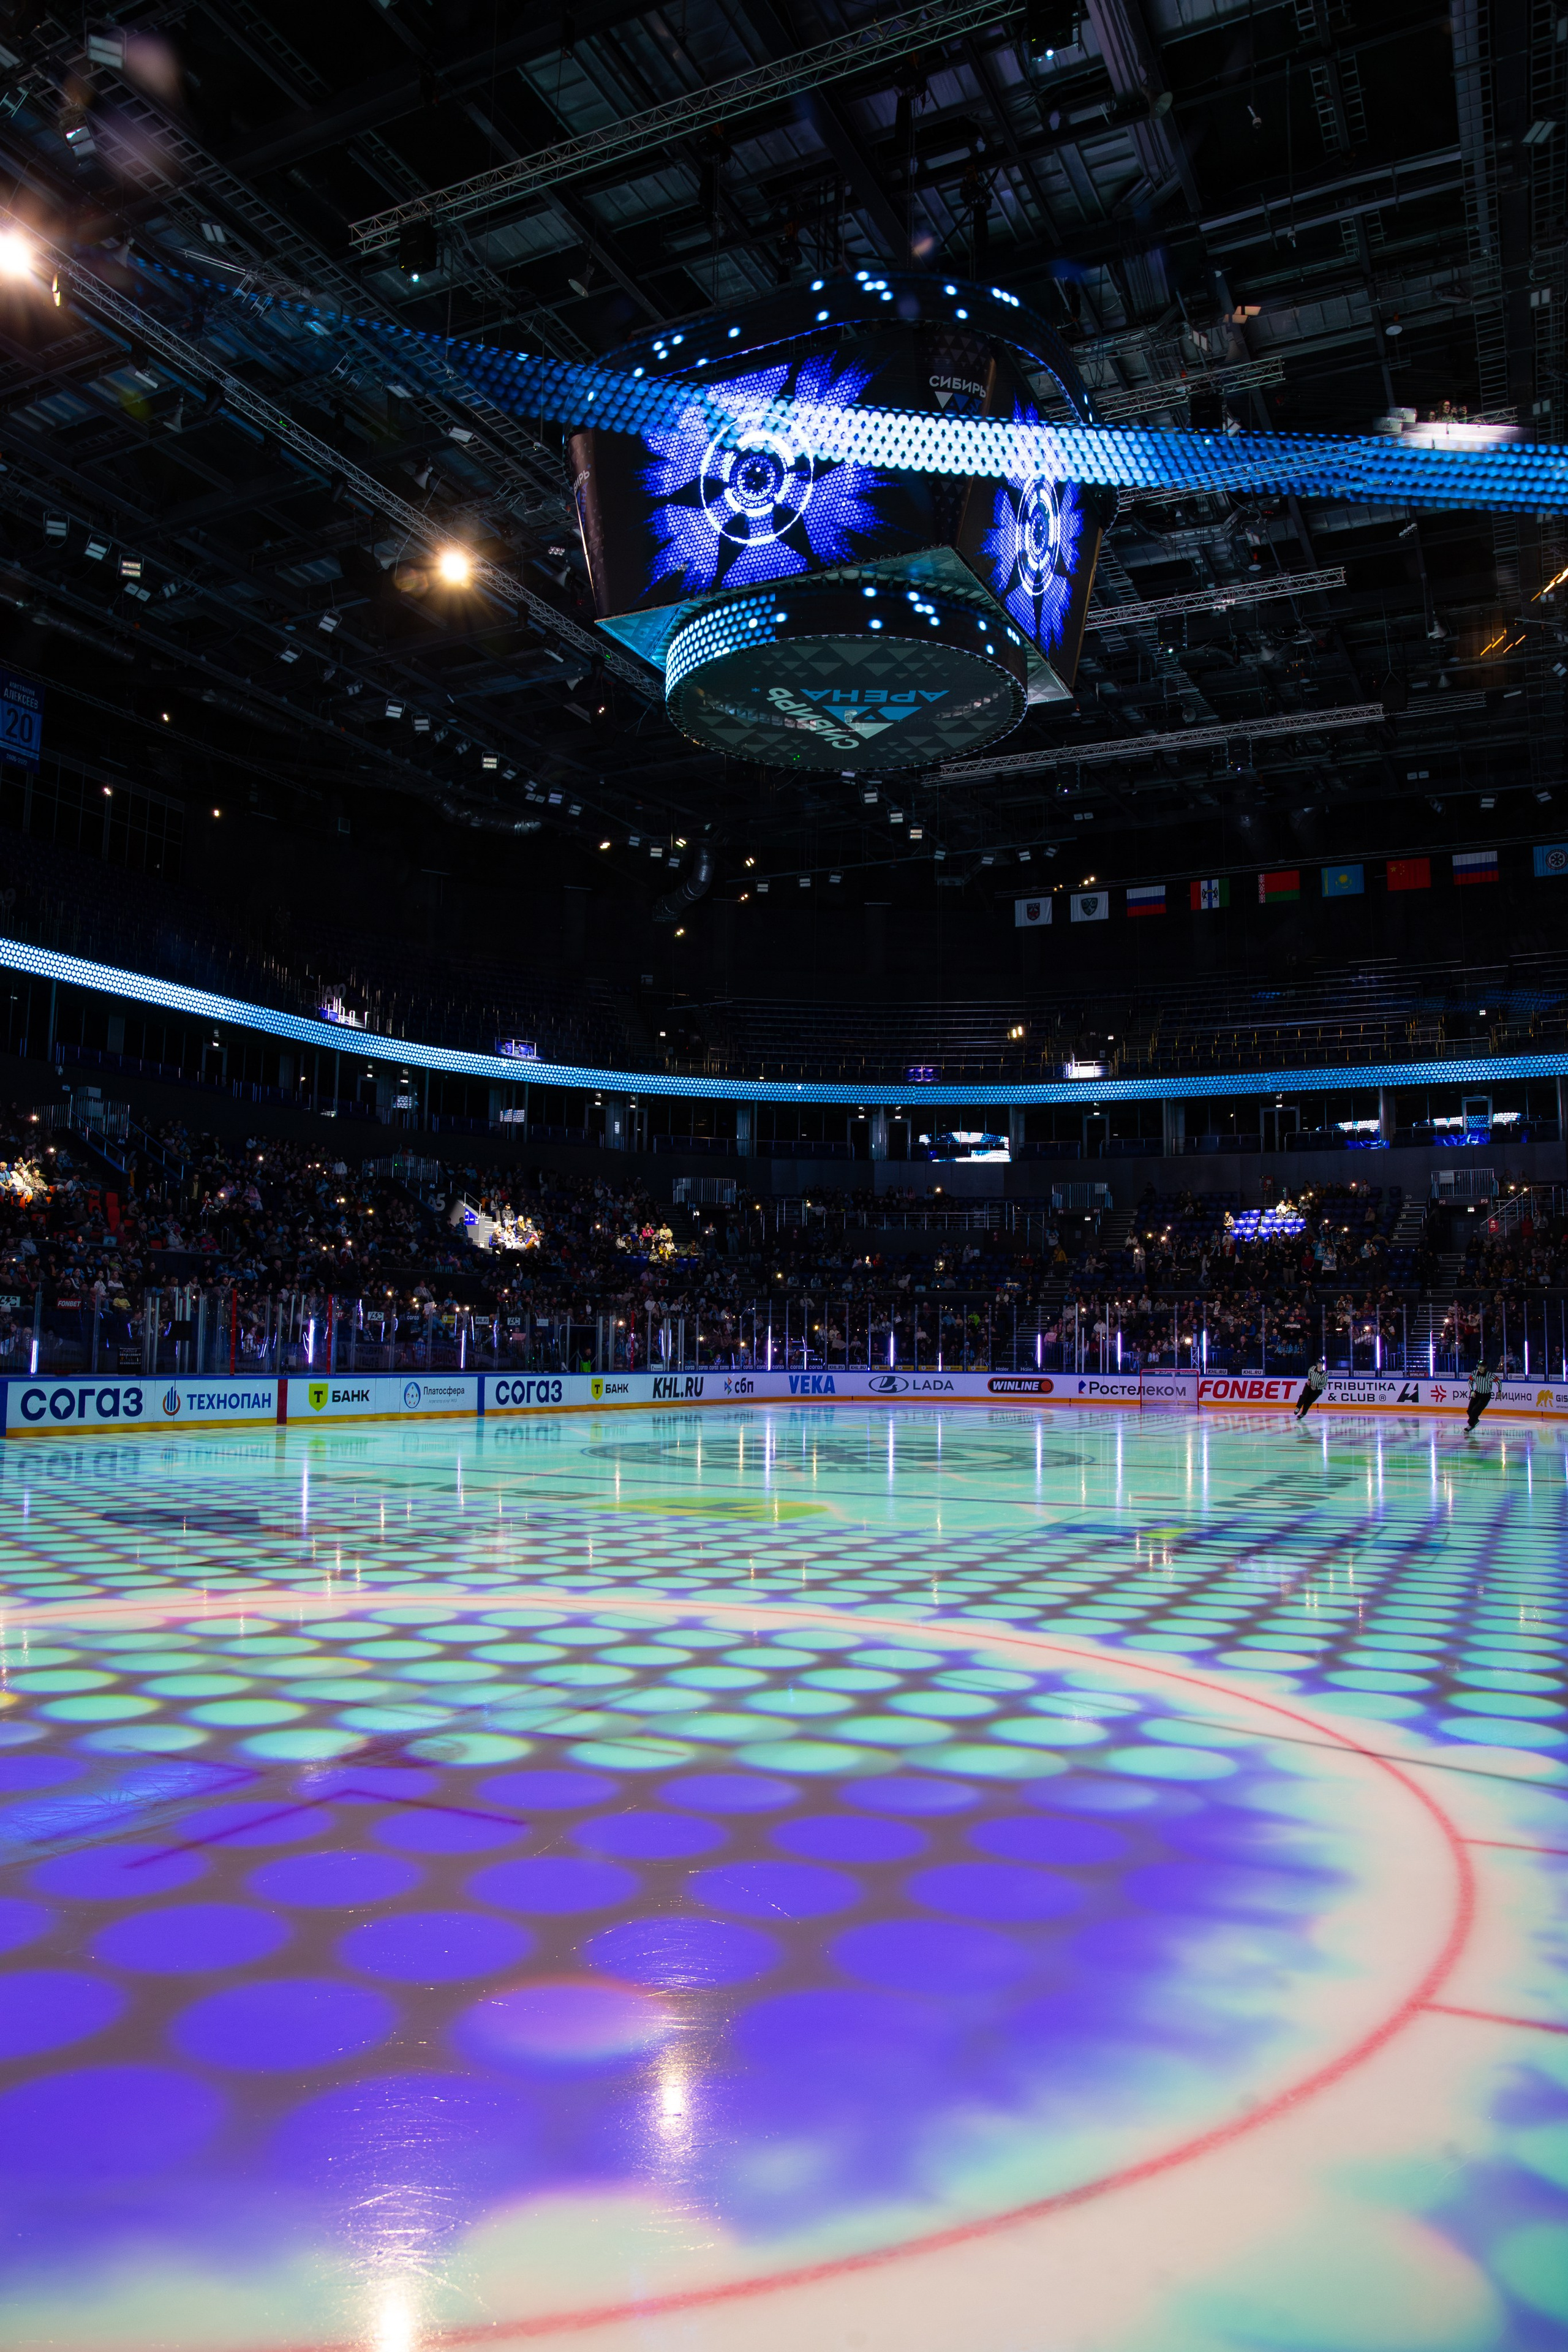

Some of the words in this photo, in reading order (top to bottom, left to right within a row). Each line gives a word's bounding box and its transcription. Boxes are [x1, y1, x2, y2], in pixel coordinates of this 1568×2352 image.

[929, 375, 987, 398] СИБИРЬ
[4, 687, 39, 709] АЛЕКСЕЕВ
[799, 688, 949, 703] АРЕНА
[6, 707, 32, 743] 20
[766, 687, 860, 749] СИБИРЬ
[423, 1386, 465, 1397] Платосфера
[605, 1384, 629, 1394] БАНК
[652, 1376, 704, 1398] KHL.RU
[734, 1378, 754, 1393] сбп
[788, 1375, 835, 1393] VEKA
[913, 1380, 954, 1390] LADA
[993, 1381, 1039, 1391] WINLINE
[1089, 1381, 1186, 1396] Ростелеком
[1199, 1380, 1297, 1399] FONBET
[1324, 1382, 1396, 1391] TRIBUTIKA
[187, 1393, 271, 1410] ТЕХНОПАН
[332, 1390, 370, 1403] БАНК
[1328, 1393, 1336, 1401] &
[1341, 1393, 1375, 1402] CLUB
[1490, 1392, 1532, 1401] едицина
